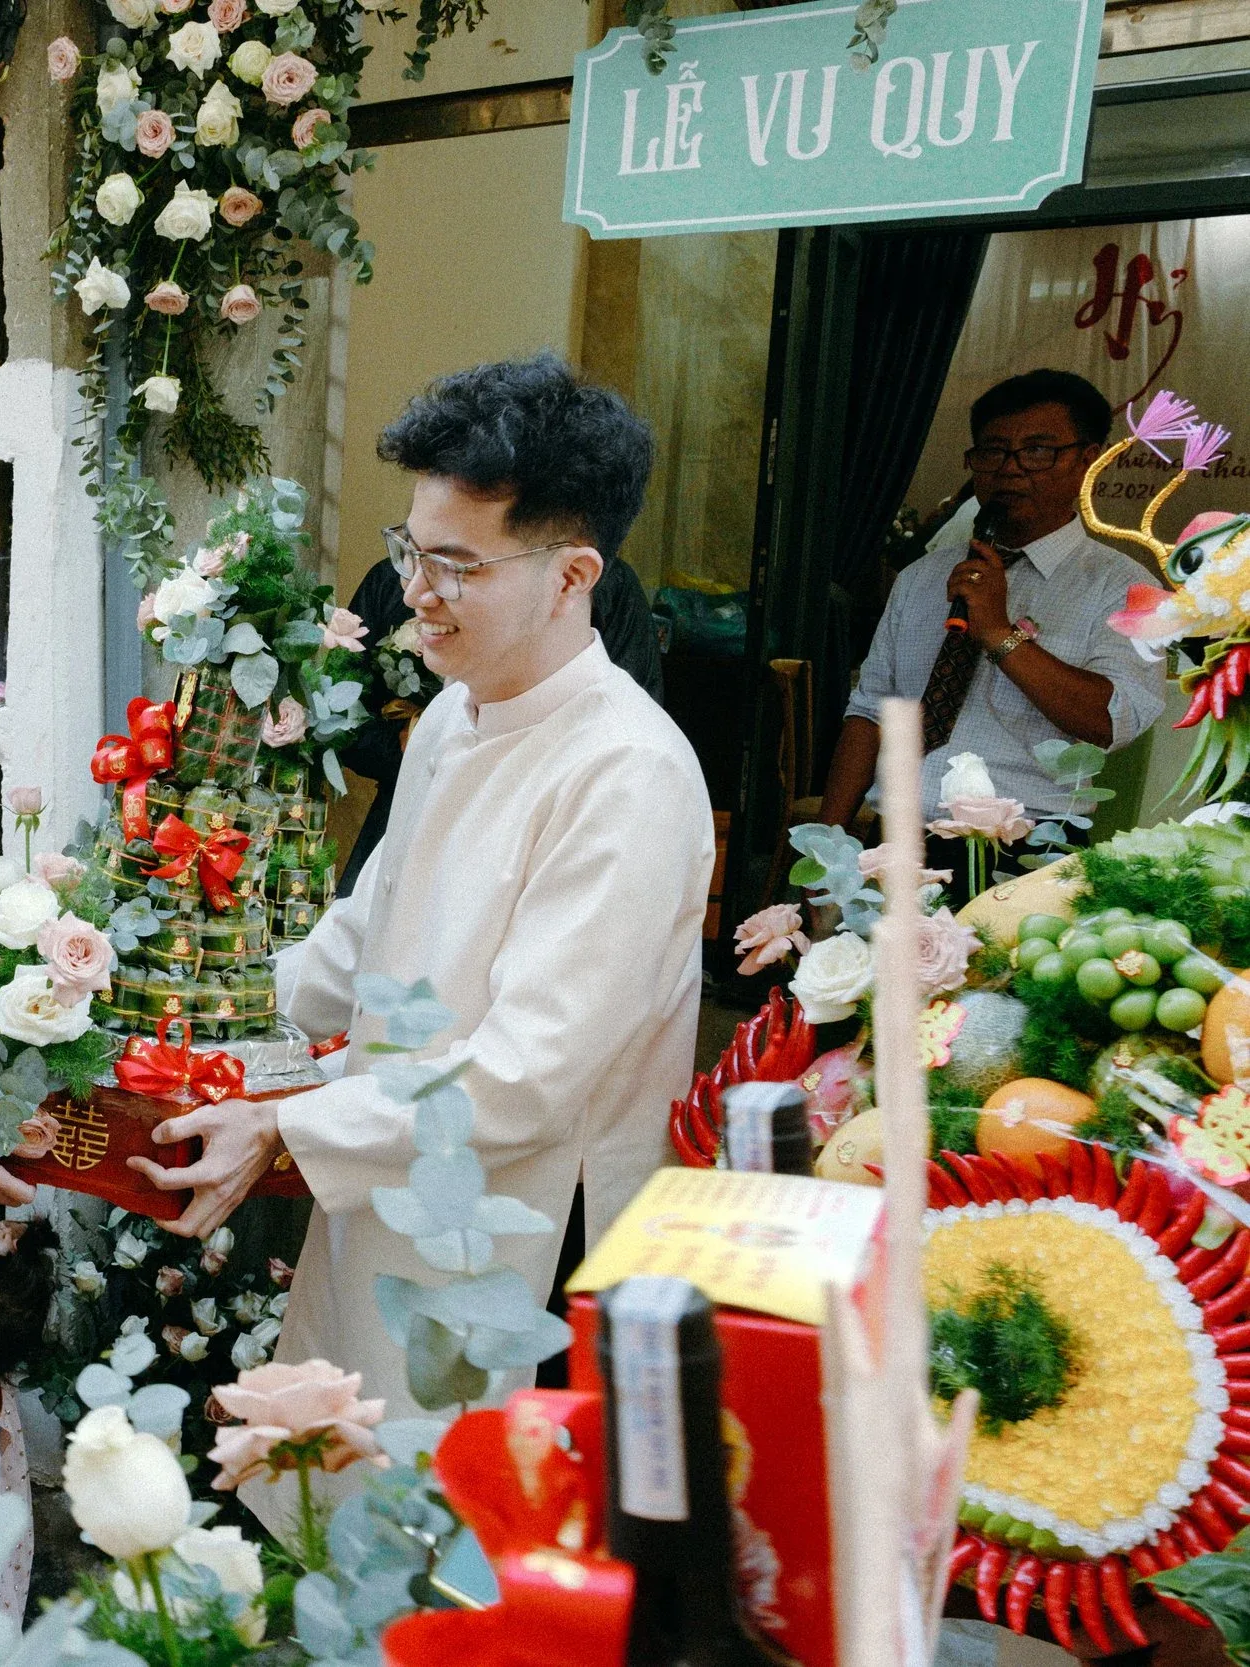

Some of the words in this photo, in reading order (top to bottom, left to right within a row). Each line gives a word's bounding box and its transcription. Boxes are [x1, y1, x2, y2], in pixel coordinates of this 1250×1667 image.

[617, 59, 707, 176] LỄ
[740, 64, 842, 167] VU
[869, 39, 1043, 160] QUY
